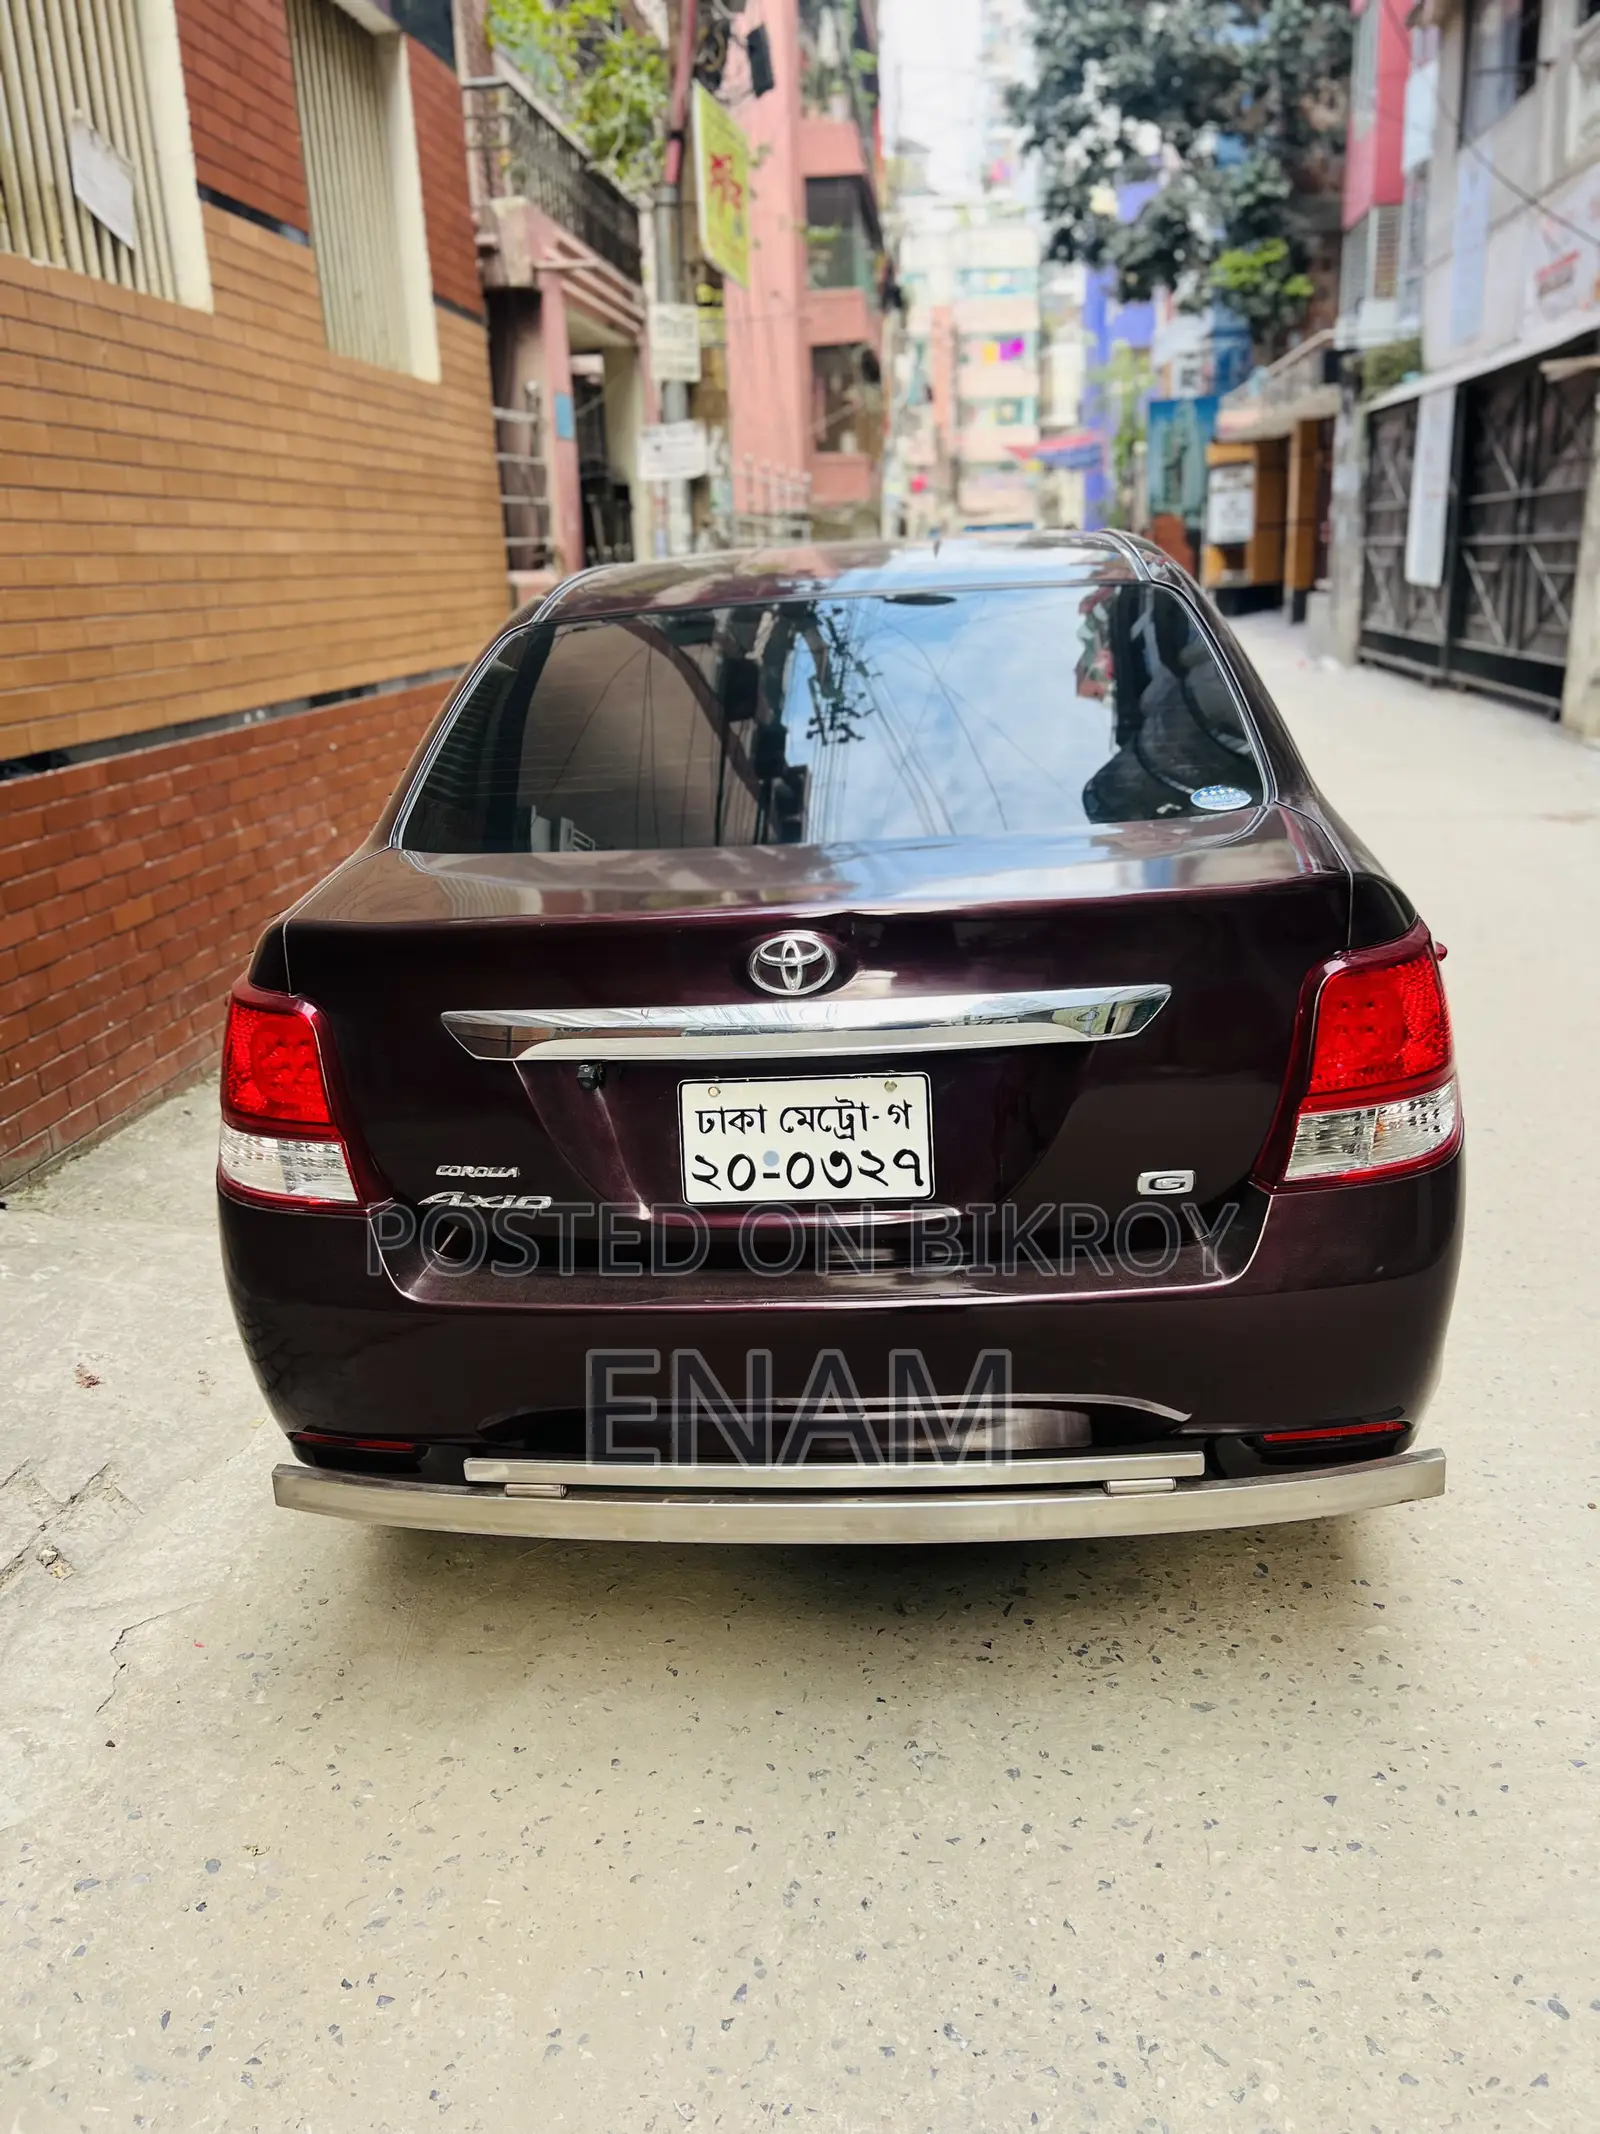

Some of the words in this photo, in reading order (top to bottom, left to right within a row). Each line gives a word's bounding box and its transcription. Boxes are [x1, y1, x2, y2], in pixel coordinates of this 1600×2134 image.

[695, 1103, 767, 1134] ঢাকা
[436, 1164, 519, 1178] COROLLA
[691, 1148, 925, 1191] ২০-০৩২৭
